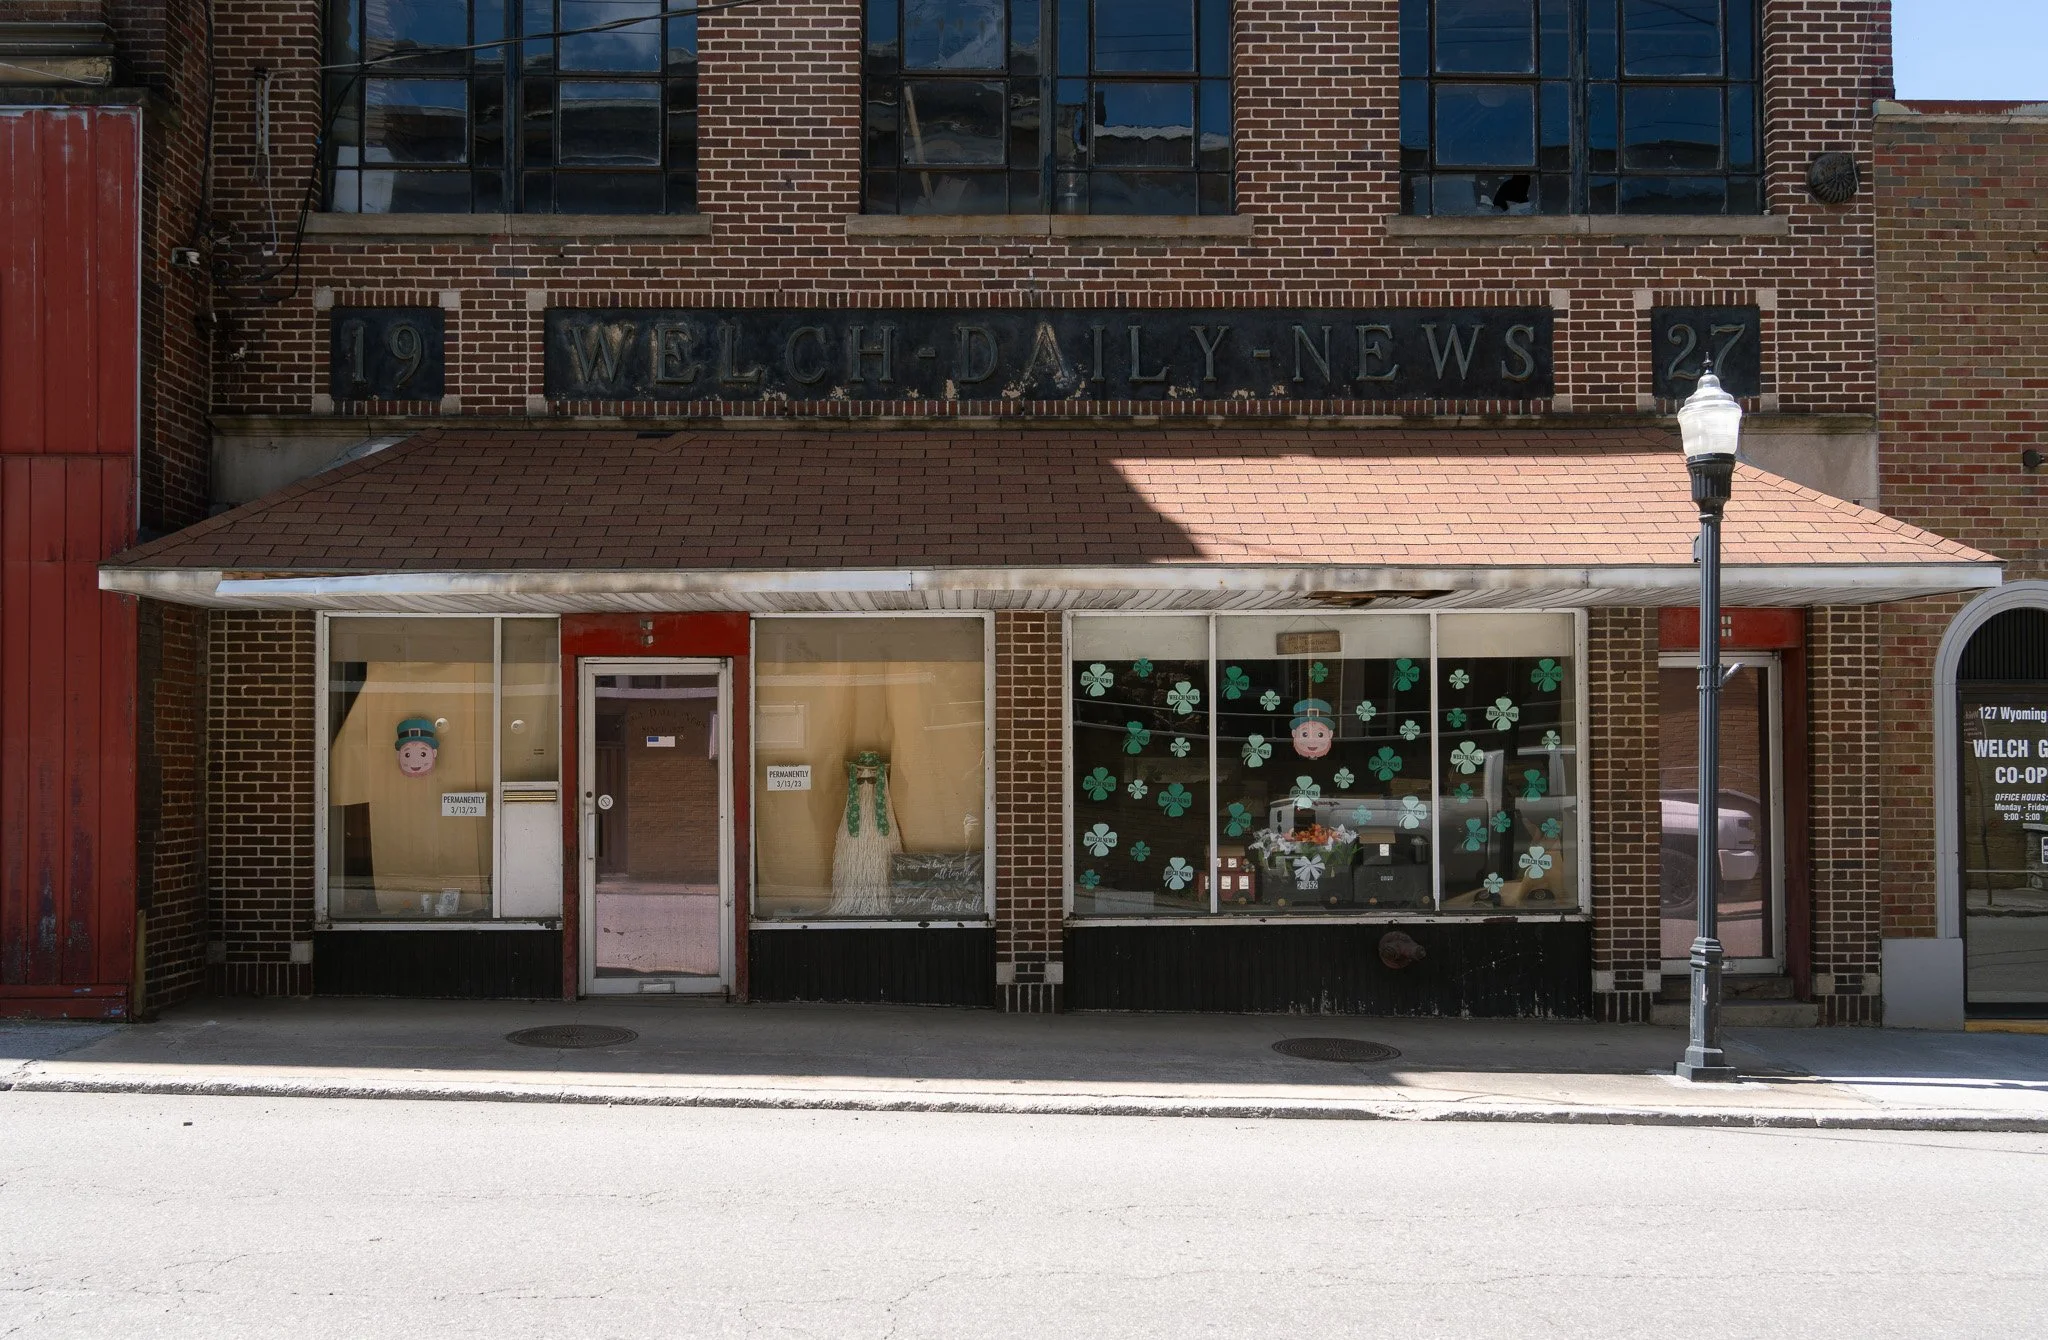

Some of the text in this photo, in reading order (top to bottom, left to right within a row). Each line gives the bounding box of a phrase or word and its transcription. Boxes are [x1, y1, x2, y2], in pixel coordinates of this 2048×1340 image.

[348, 322, 423, 389] 19
[1667, 323, 1746, 380] 27
[1978, 706, 1997, 720] 127
[2000, 706, 2047, 723] Wyoming
[1973, 739, 2028, 758] WELCH
[1995, 766, 2047, 784] CO-OP
[777, 780, 802, 788] 3/13/23
[451, 807, 477, 815] 3/13/23
[2028, 803, 2048, 812] Friday
